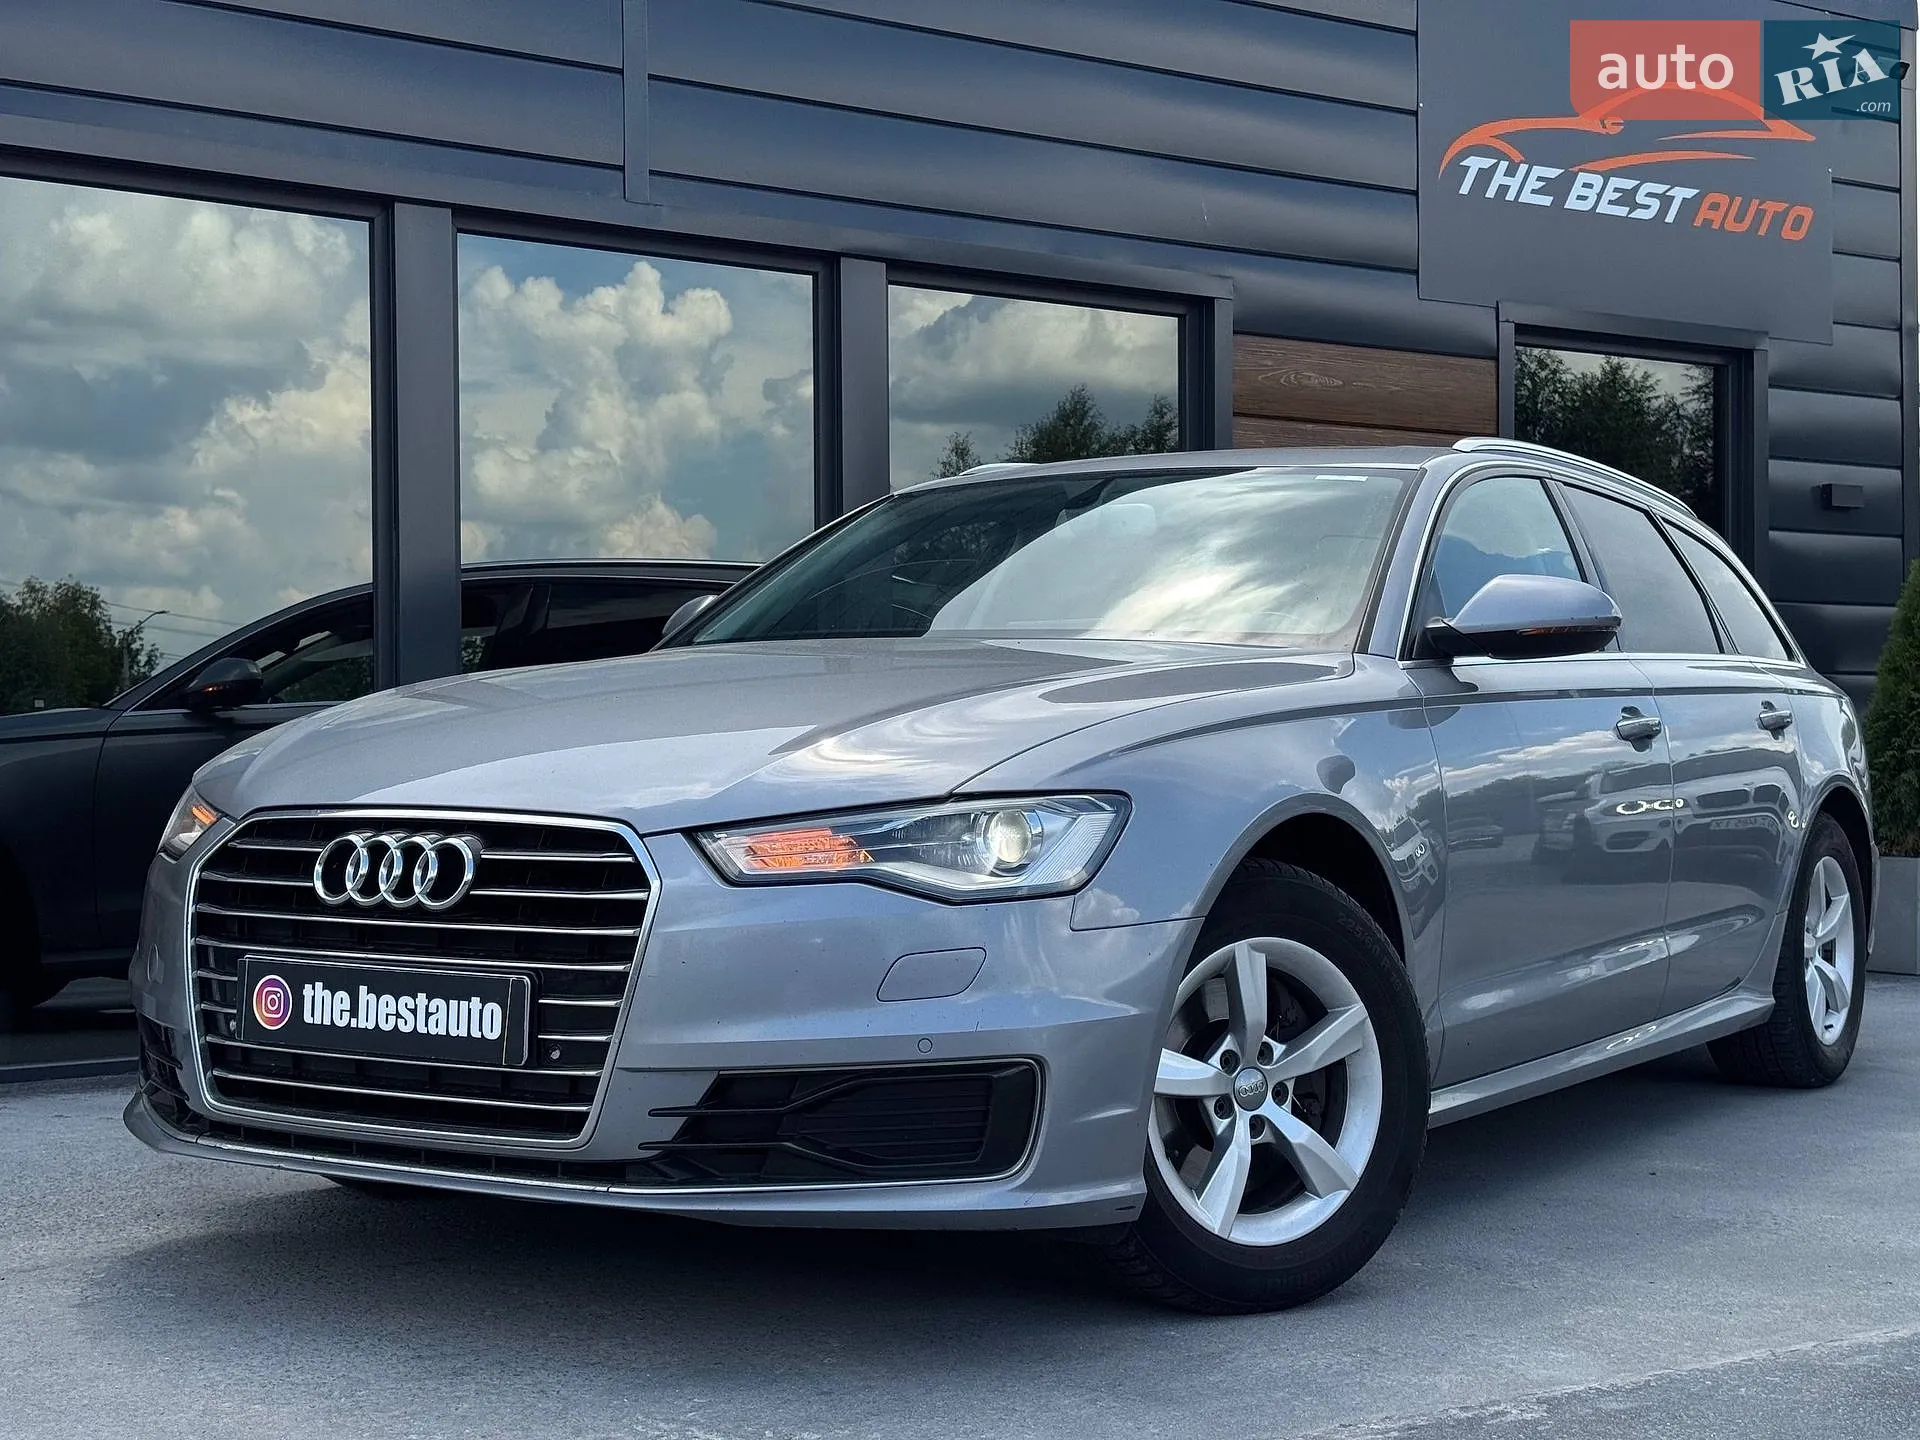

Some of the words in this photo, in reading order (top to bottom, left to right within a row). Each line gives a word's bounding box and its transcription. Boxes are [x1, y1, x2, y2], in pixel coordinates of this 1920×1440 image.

[1458, 155, 1565, 208] THE
[1563, 171, 1701, 224] BEST
[1693, 192, 1815, 241] AUTO
[302, 981, 502, 1040] the.bestauto
